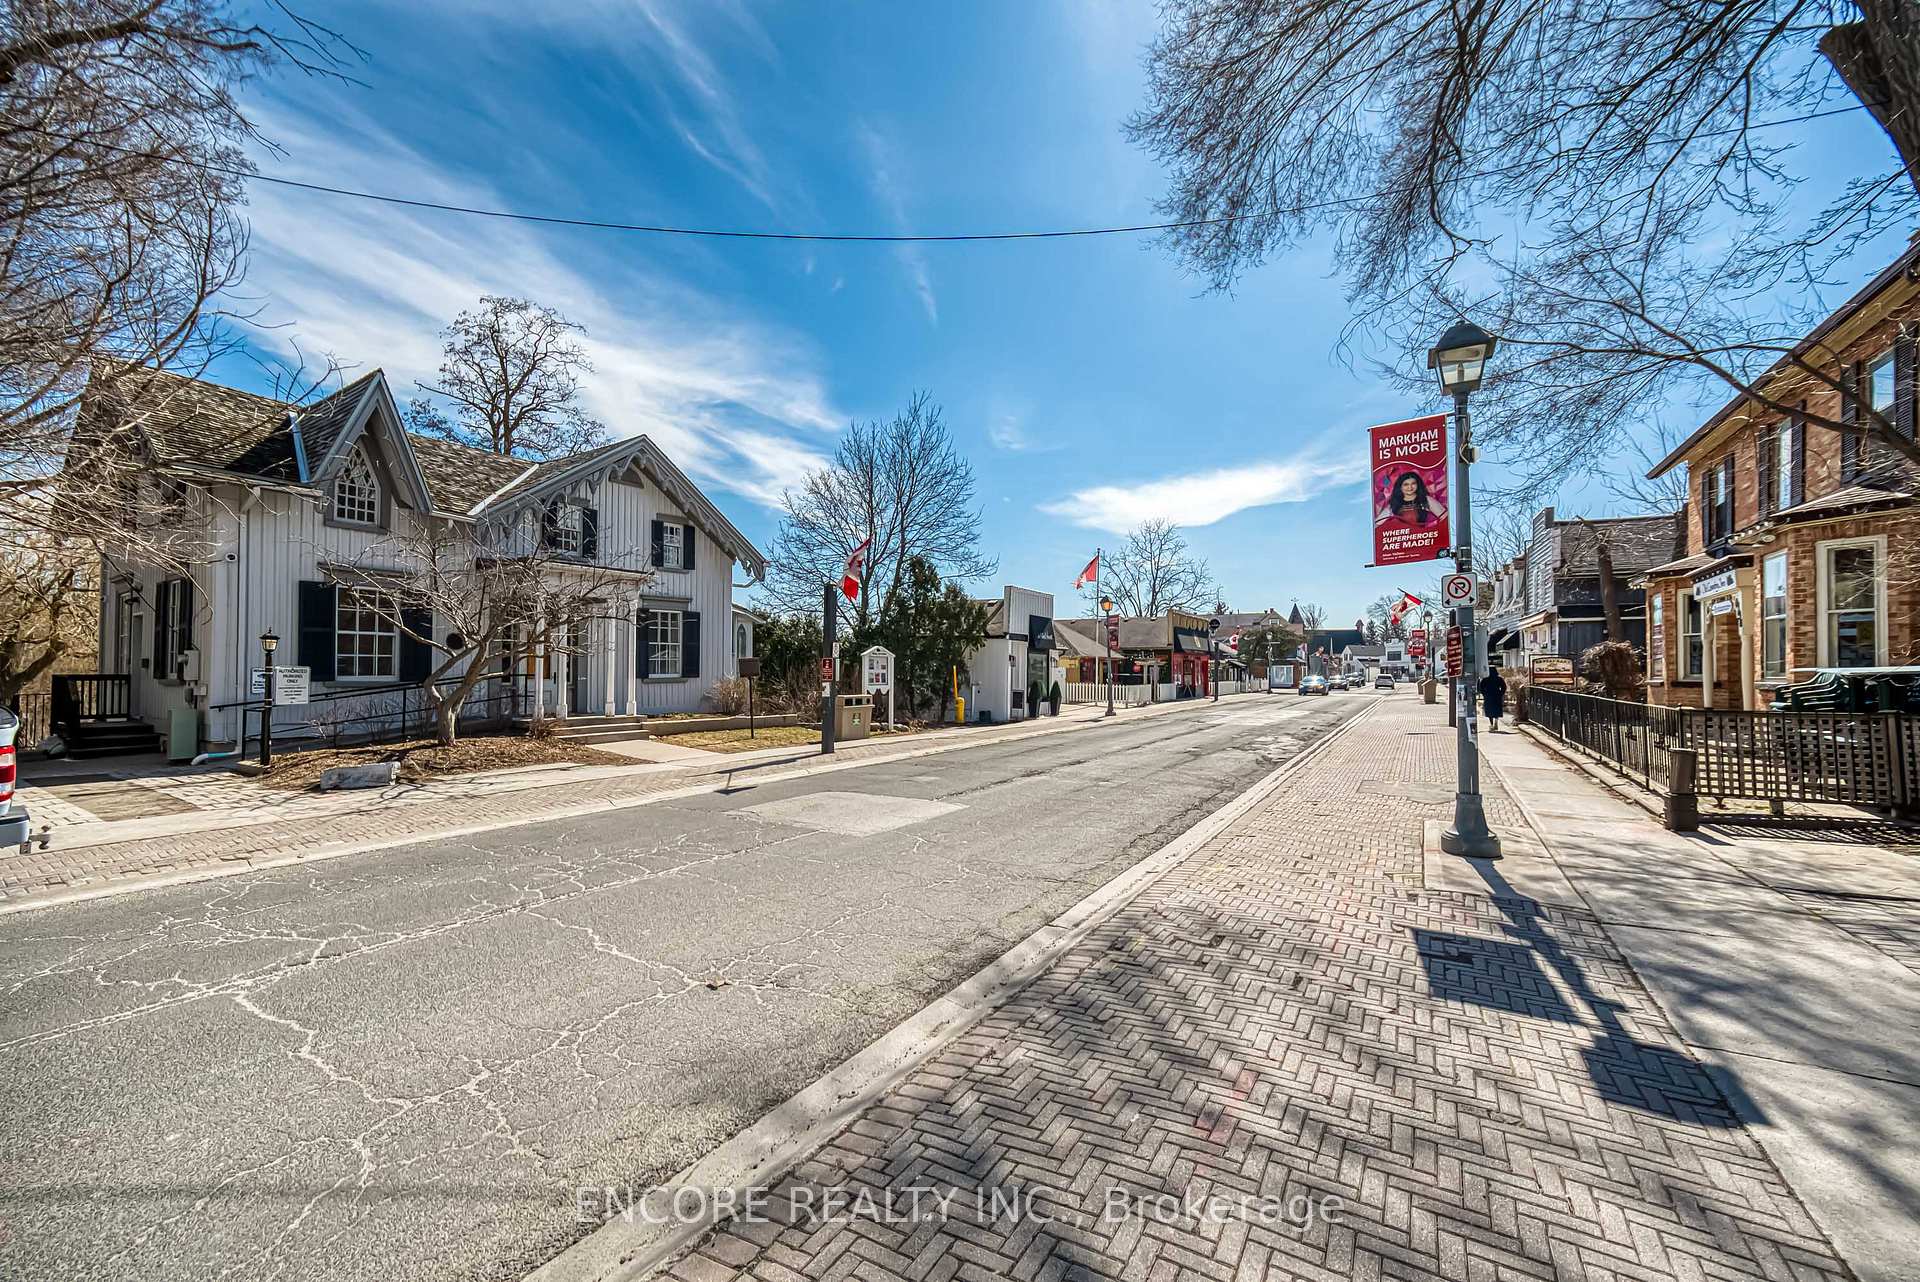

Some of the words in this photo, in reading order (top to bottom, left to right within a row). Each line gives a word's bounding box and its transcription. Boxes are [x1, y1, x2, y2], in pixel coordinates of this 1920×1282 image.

[1379, 429, 1438, 448] MARKHAM
[1379, 449, 1391, 460] IS
[1396, 440, 1439, 457] MORE
[1382, 528, 1410, 537] WHERE
[1382, 531, 1439, 544] SUPERHEROES
[1382, 542, 1401, 551] ARE
[1402, 538, 1434, 549] MADE!
